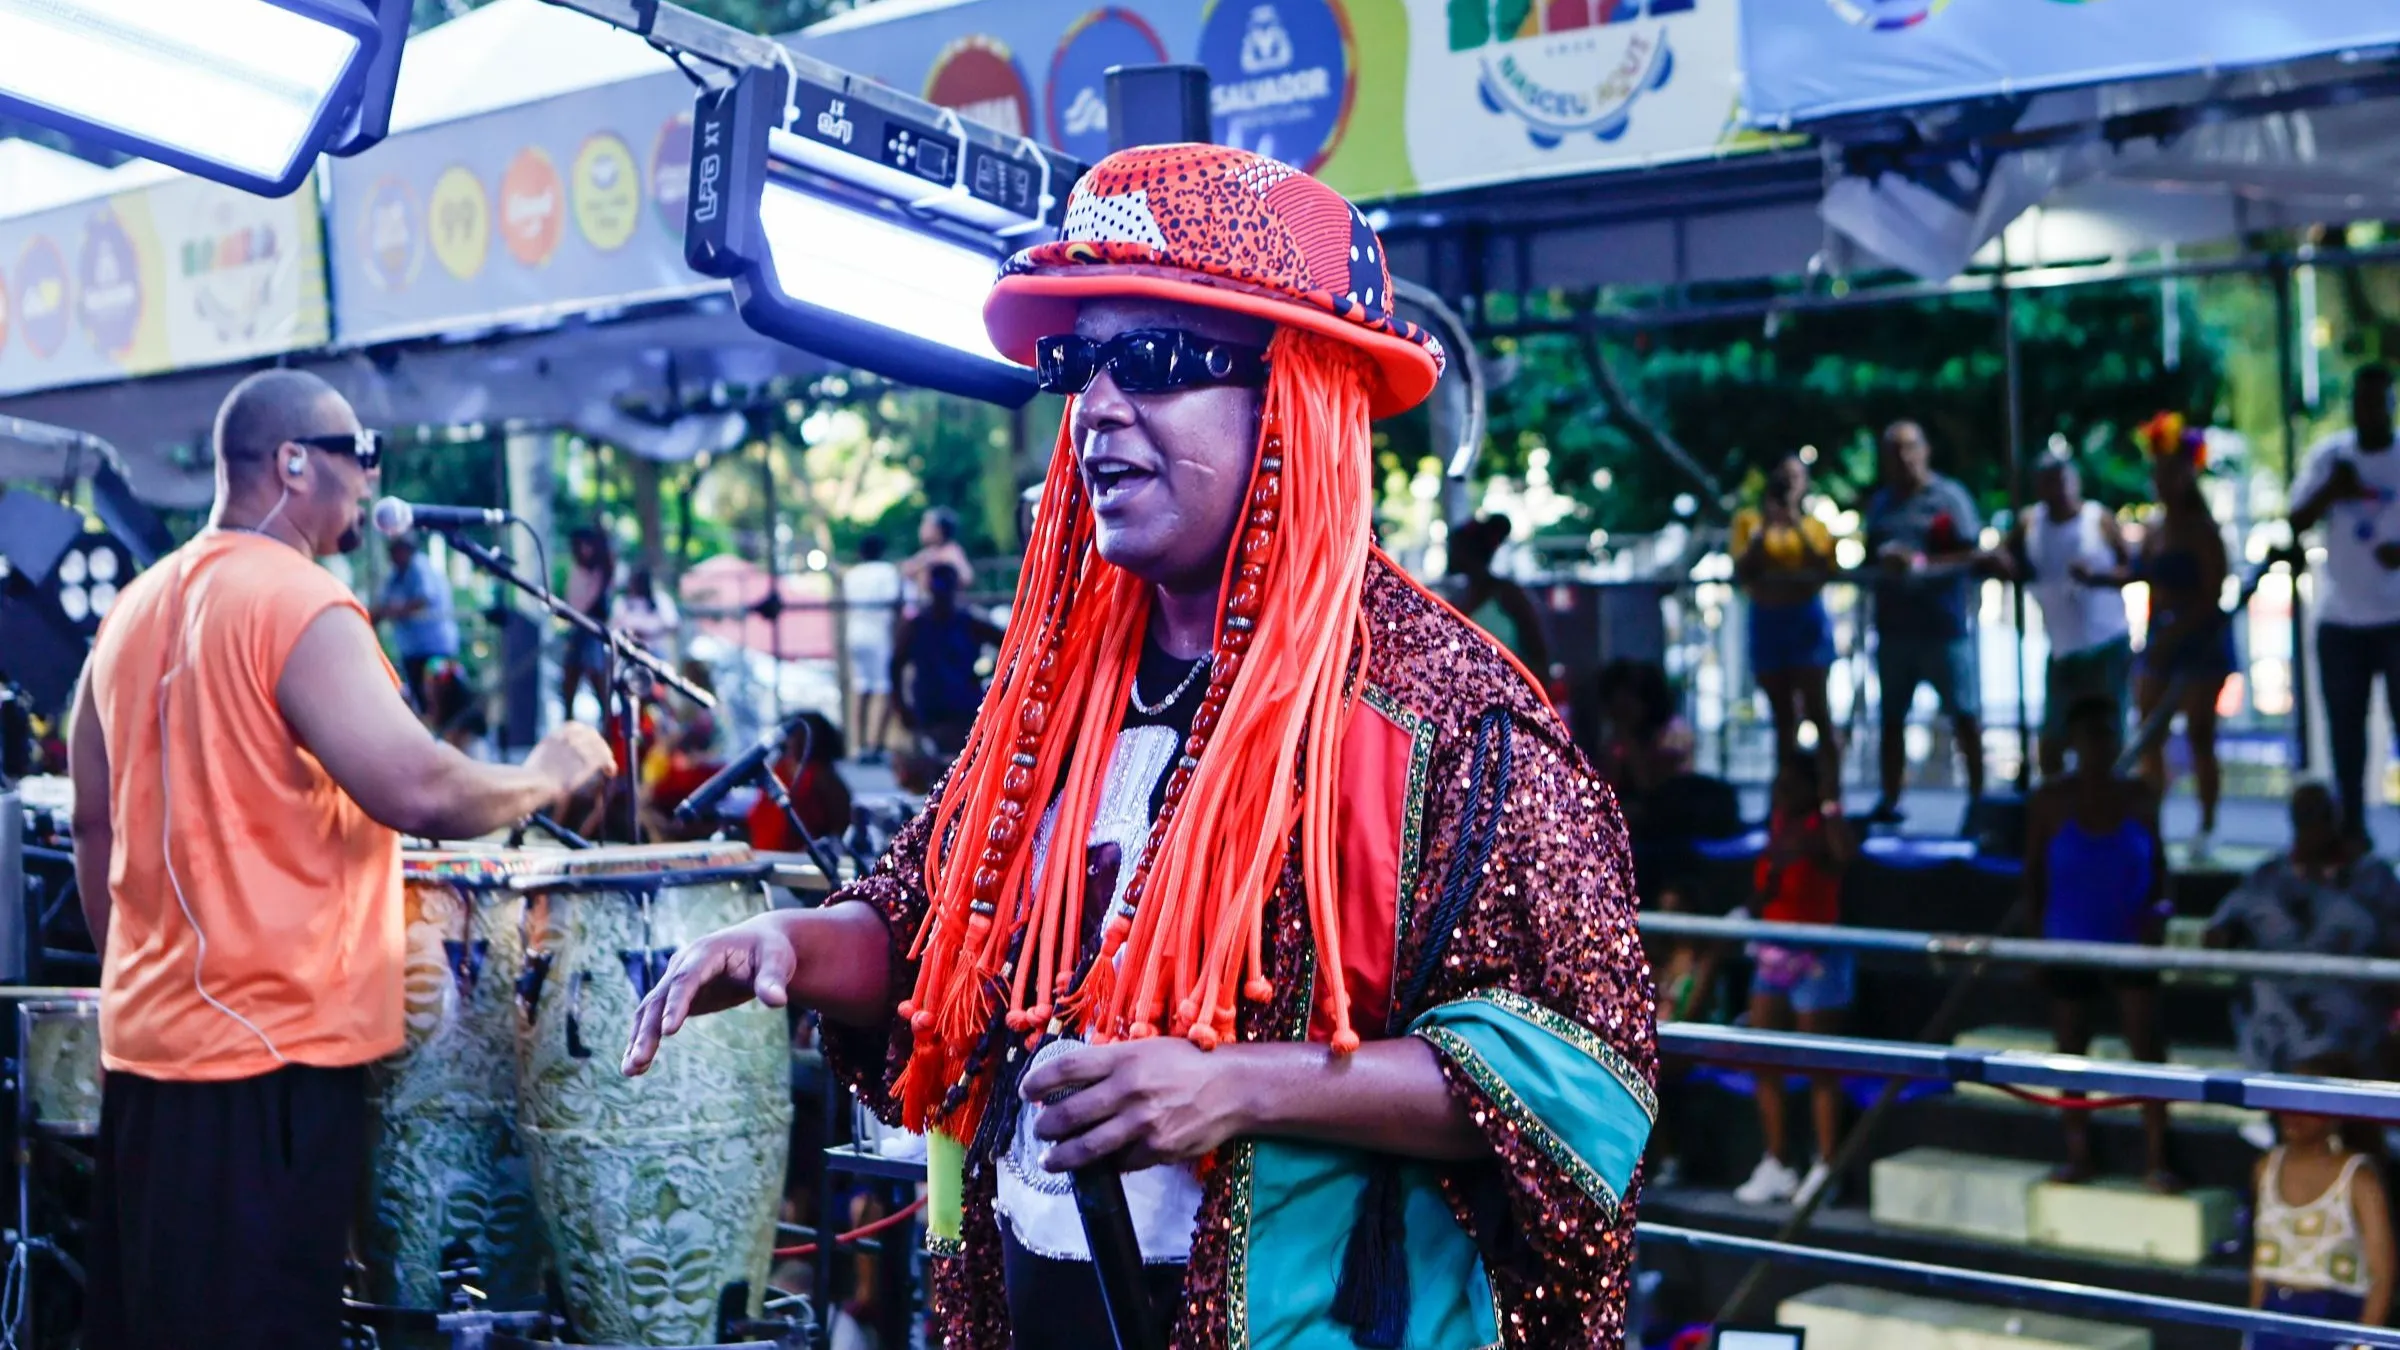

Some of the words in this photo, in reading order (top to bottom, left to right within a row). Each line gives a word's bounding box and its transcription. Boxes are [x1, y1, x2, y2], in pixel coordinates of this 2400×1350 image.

[1210, 66, 1330, 117] SALVADOR
[704, 121, 720, 149] XT
[694, 153, 720, 223] LPG
